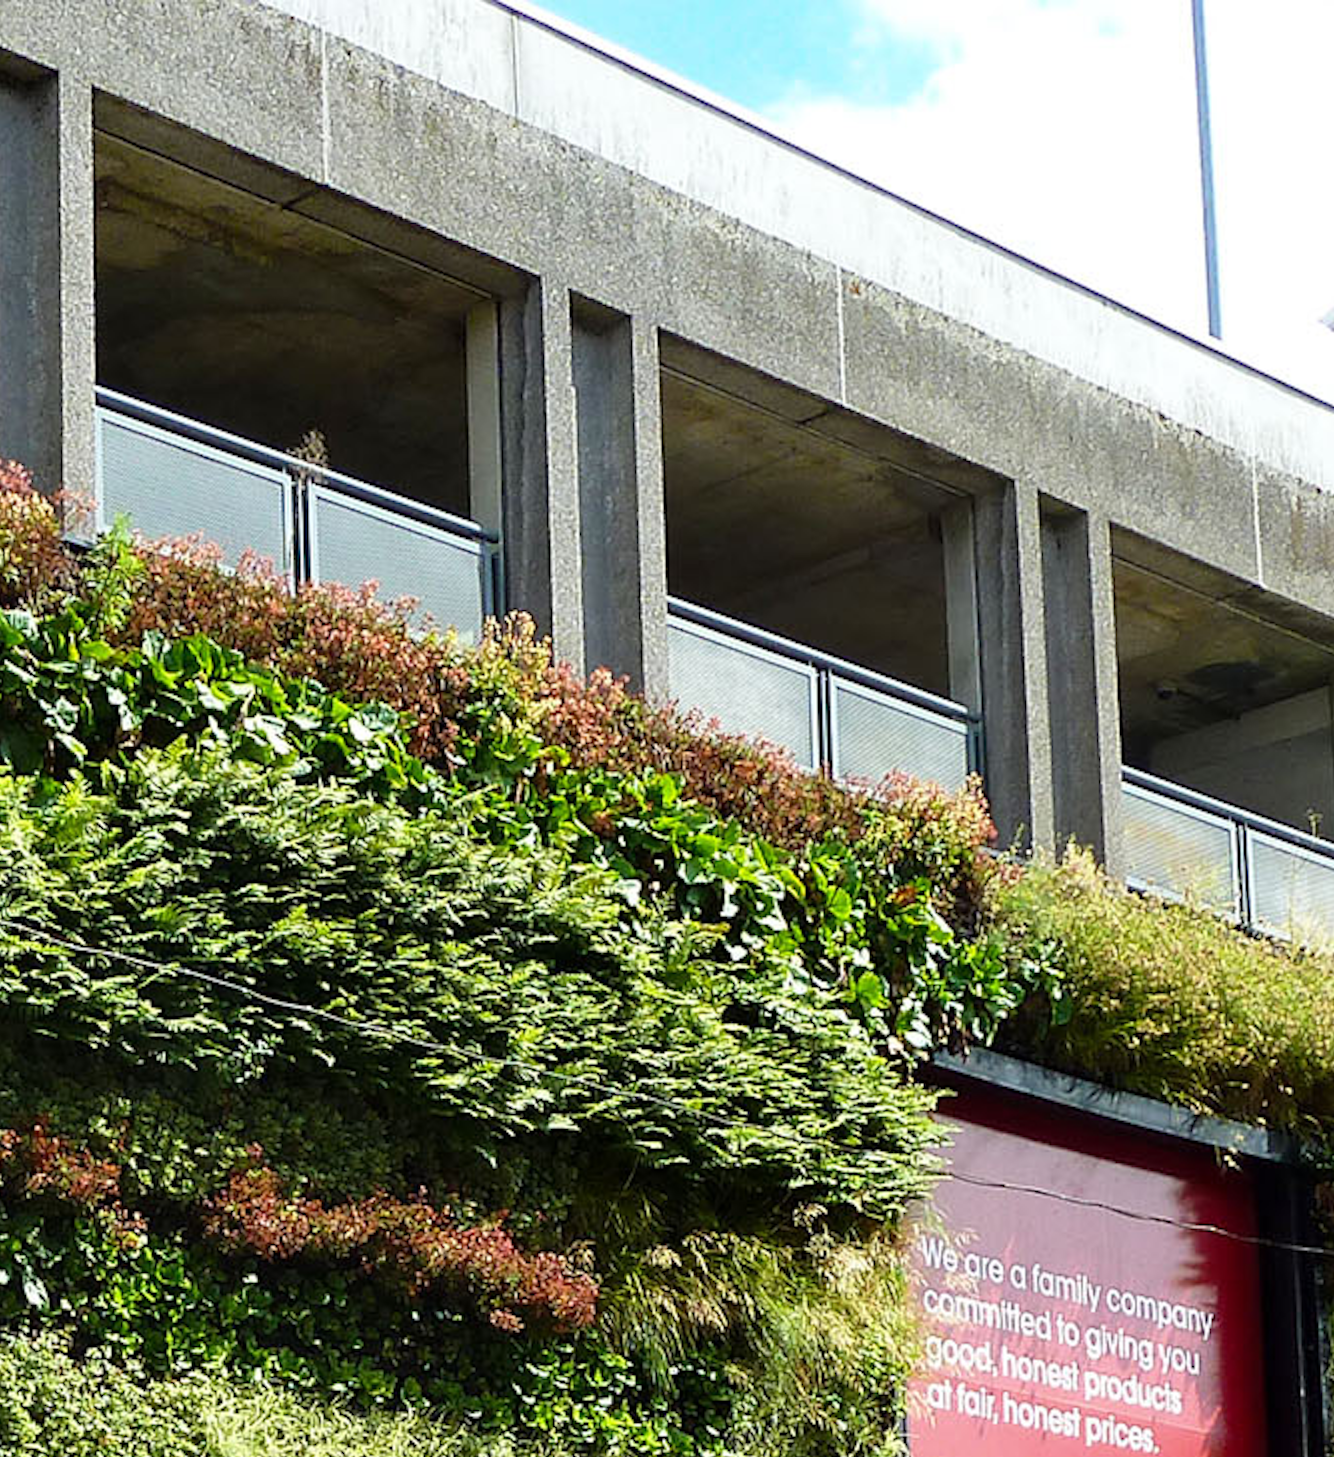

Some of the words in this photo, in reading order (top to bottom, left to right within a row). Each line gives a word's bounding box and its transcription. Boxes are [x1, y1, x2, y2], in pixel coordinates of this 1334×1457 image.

[921, 1236, 958, 1271] We
[964, 1253, 1003, 1283] are
[1011, 1265, 1026, 1290] a
[1033, 1264, 1101, 1311] family
[1106, 1289, 1214, 1340] company
[924, 1289, 1051, 1341] committed
[1057, 1314, 1079, 1345] to
[1086, 1326, 1154, 1370] giving
[1158, 1342, 1200, 1375] you
[926, 1335, 999, 1376] good,
[1002, 1345, 1078, 1391] honest
[1084, 1369, 1183, 1414] products
[927, 1380, 953, 1409] at
[957, 1384, 999, 1424] fair,
[1003, 1391, 1080, 1438] honest
[1085, 1413, 1160, 1454] prices.
